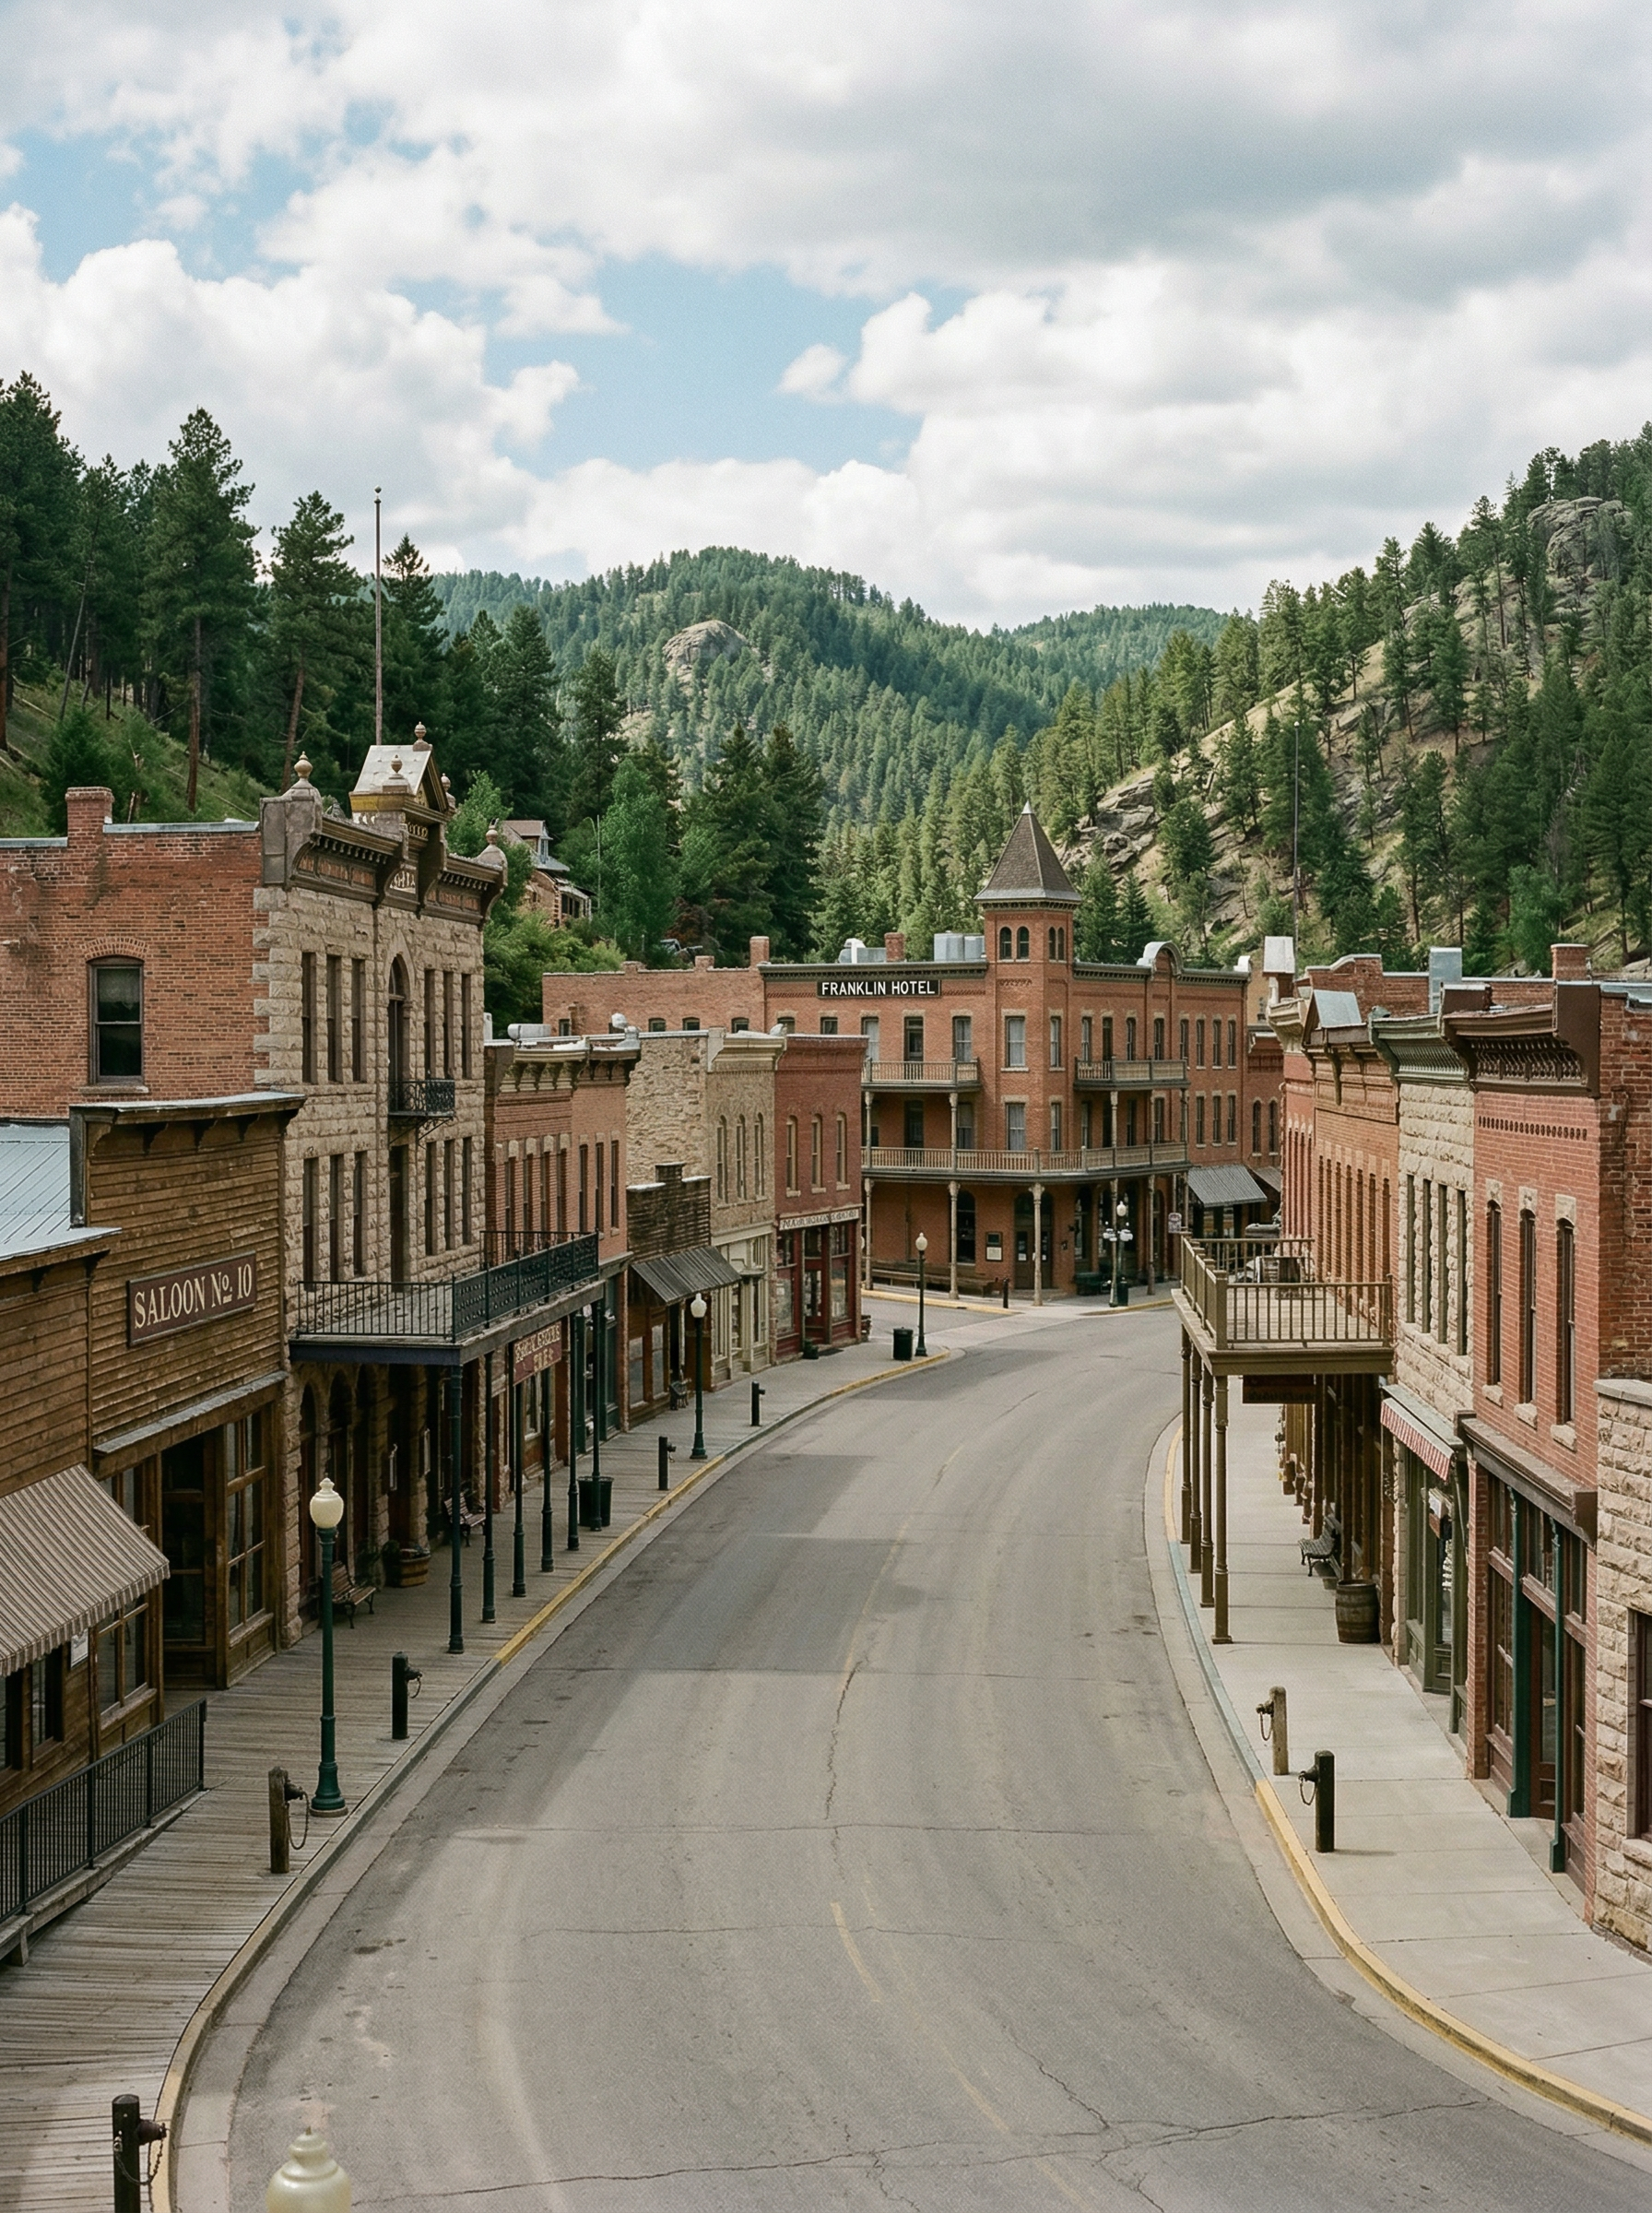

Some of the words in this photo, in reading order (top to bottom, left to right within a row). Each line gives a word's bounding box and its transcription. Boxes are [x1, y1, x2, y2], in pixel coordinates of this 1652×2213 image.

[821, 981, 886, 995] FRANKLIN
[891, 981, 935, 995] HOTEL
[135, 1276, 206, 1329] SALOON
[237, 1263, 252, 1300] 10
